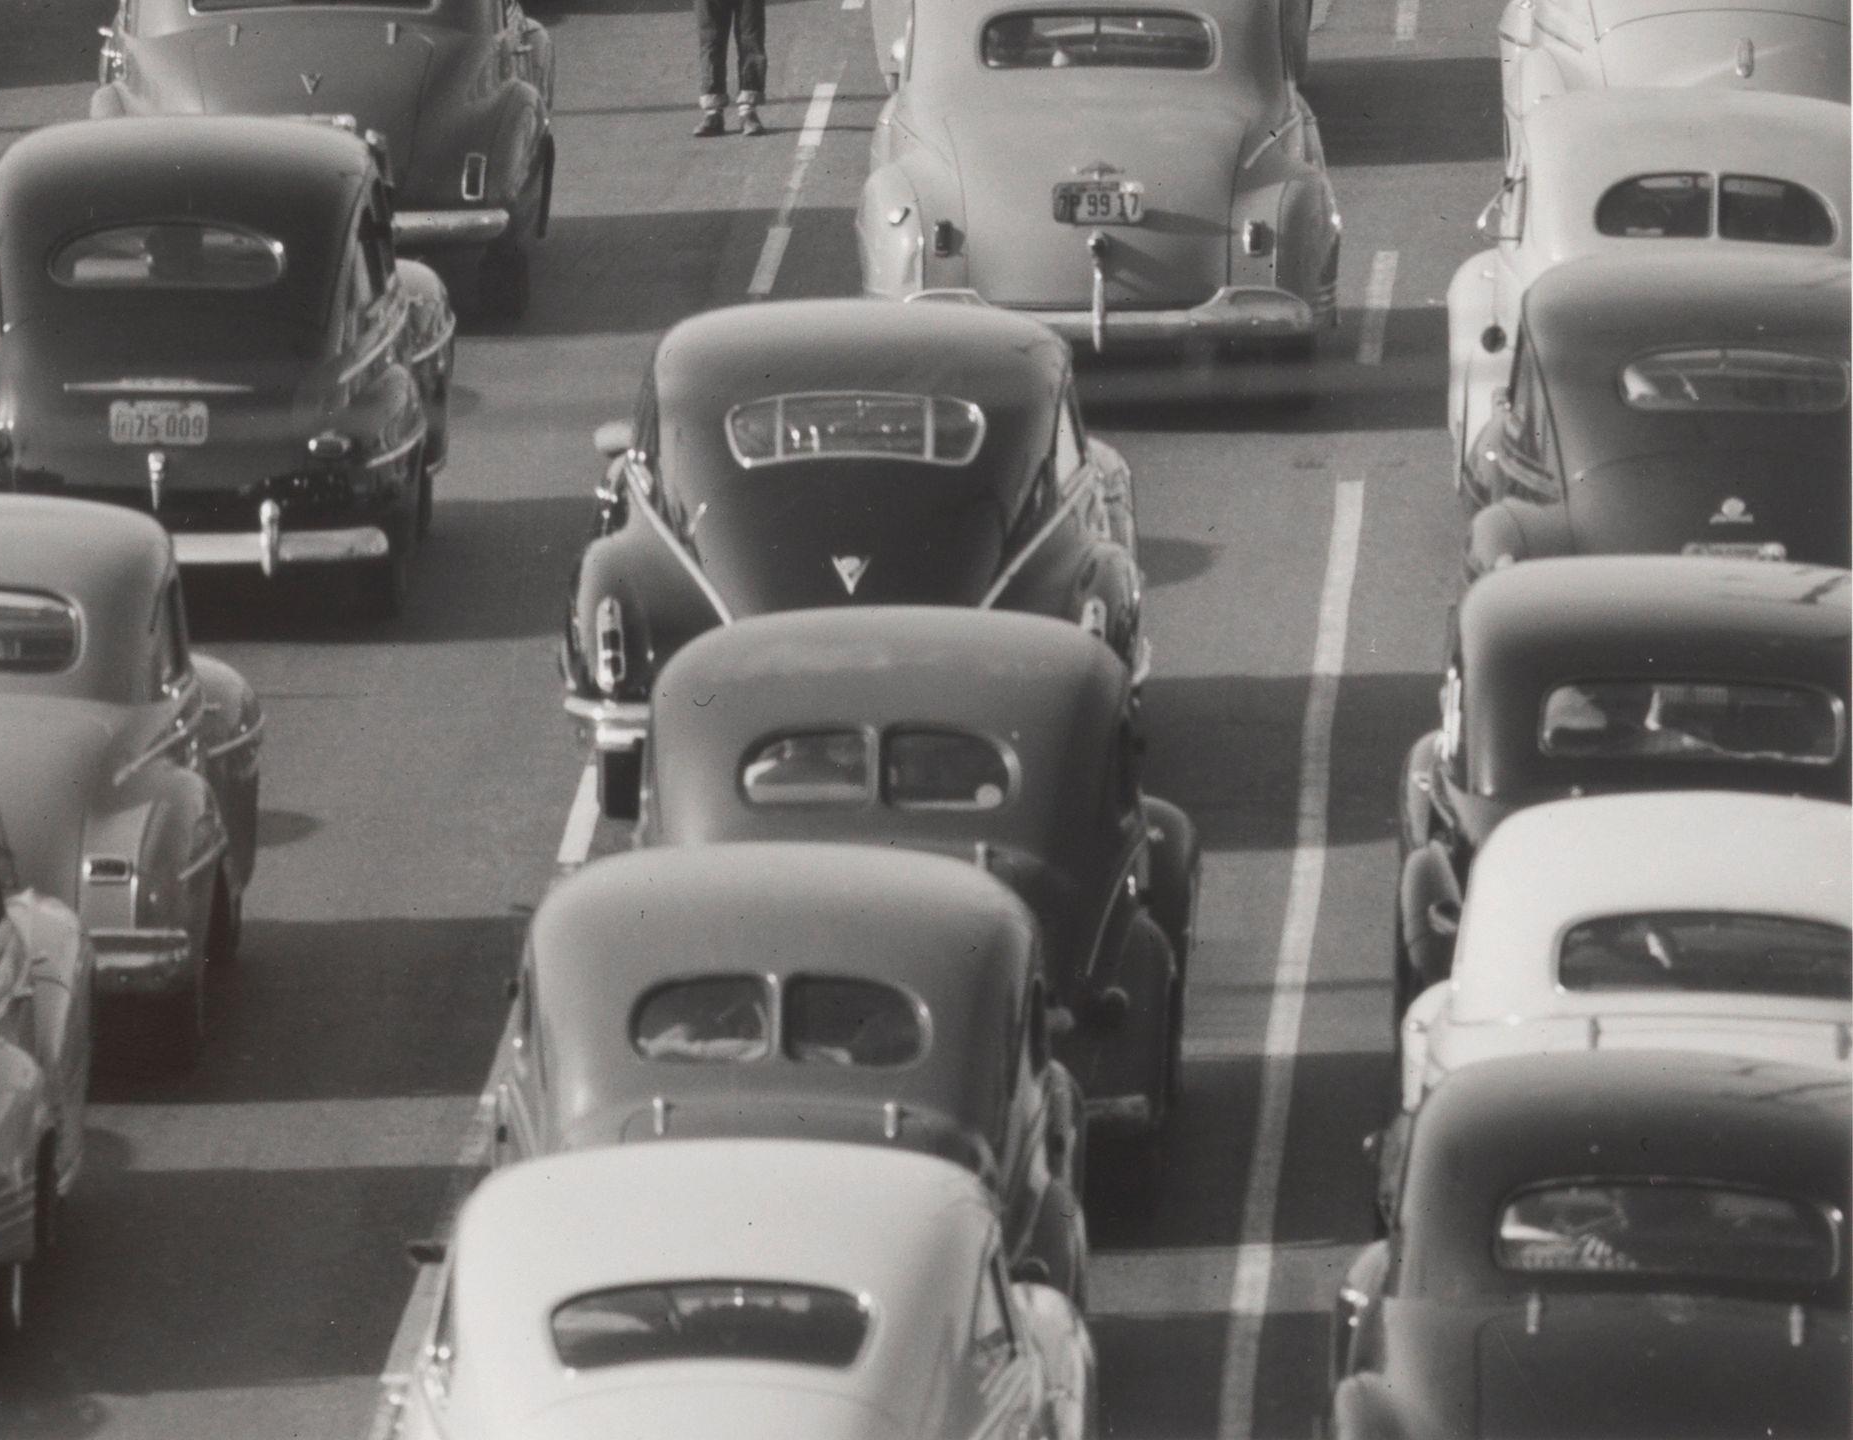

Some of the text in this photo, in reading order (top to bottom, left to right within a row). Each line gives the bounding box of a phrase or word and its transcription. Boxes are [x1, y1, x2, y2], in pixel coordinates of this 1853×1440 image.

[1087, 193, 1111, 217] 99
[1116, 193, 1140, 218] 17
[134, 414, 157, 438] 75
[164, 415, 204, 439] 009
